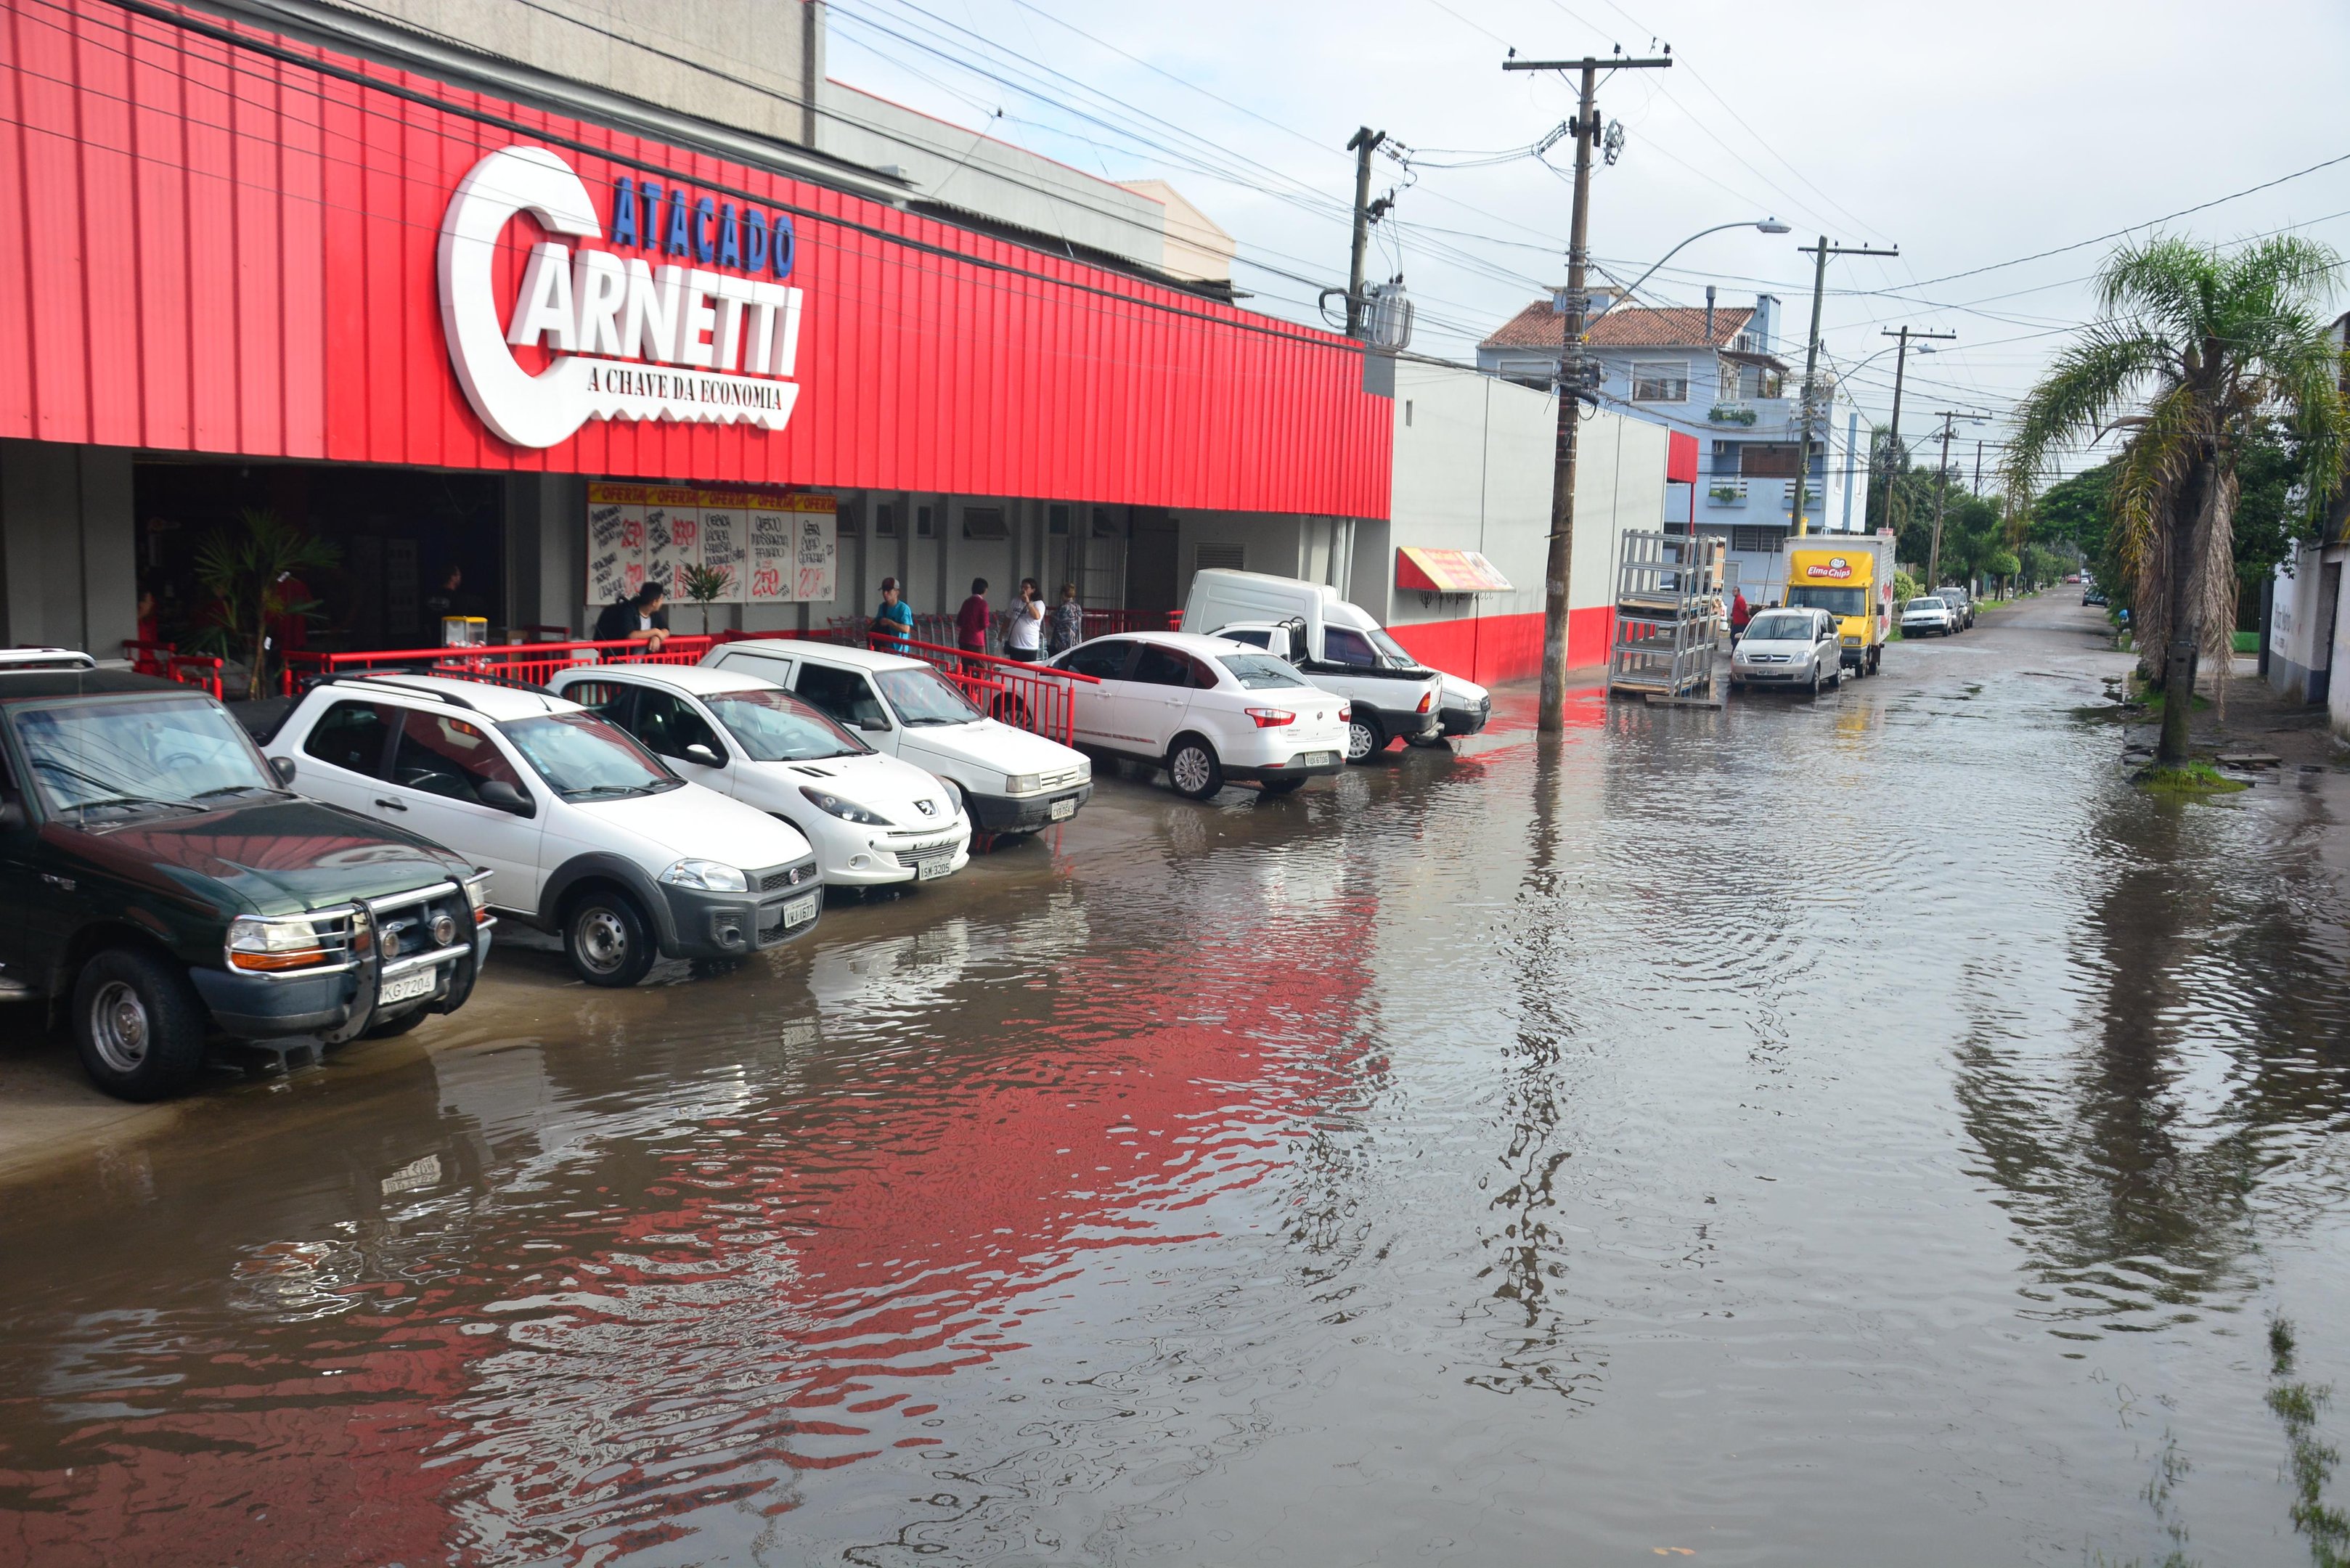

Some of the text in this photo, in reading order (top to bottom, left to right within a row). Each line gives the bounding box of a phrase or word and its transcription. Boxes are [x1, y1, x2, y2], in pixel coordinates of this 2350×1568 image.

[611, 176, 796, 279] ATACADO
[438, 145, 803, 448] CARNETTI
[587, 367, 783, 411] A CHAVE DA ECONOMIA
[1808, 566, 1851, 579] Elma Chips
